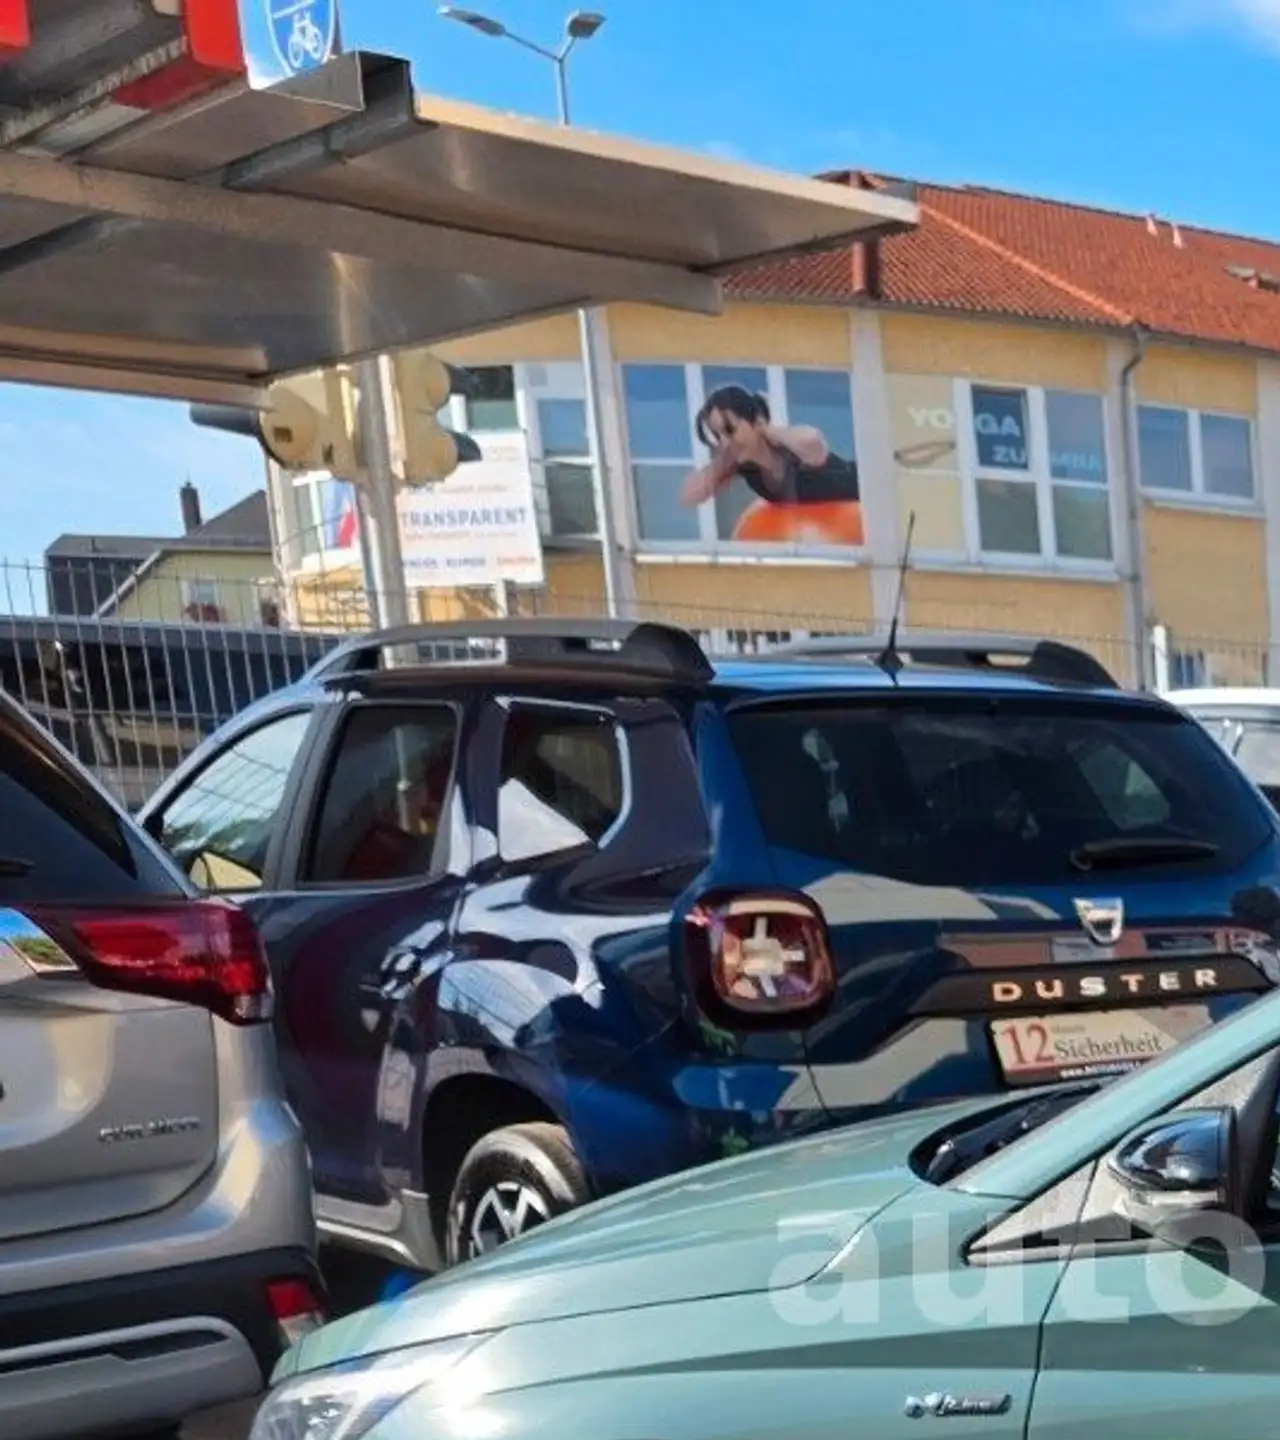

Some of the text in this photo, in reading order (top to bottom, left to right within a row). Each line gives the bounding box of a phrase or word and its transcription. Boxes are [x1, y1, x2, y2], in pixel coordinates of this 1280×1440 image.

[906, 406, 1022, 437] YOGA
[400, 506, 527, 529] TRANSPARENT
[993, 968, 1218, 1001] DUSTER
[1002, 1023, 1164, 1065] 12 Sicherheit
